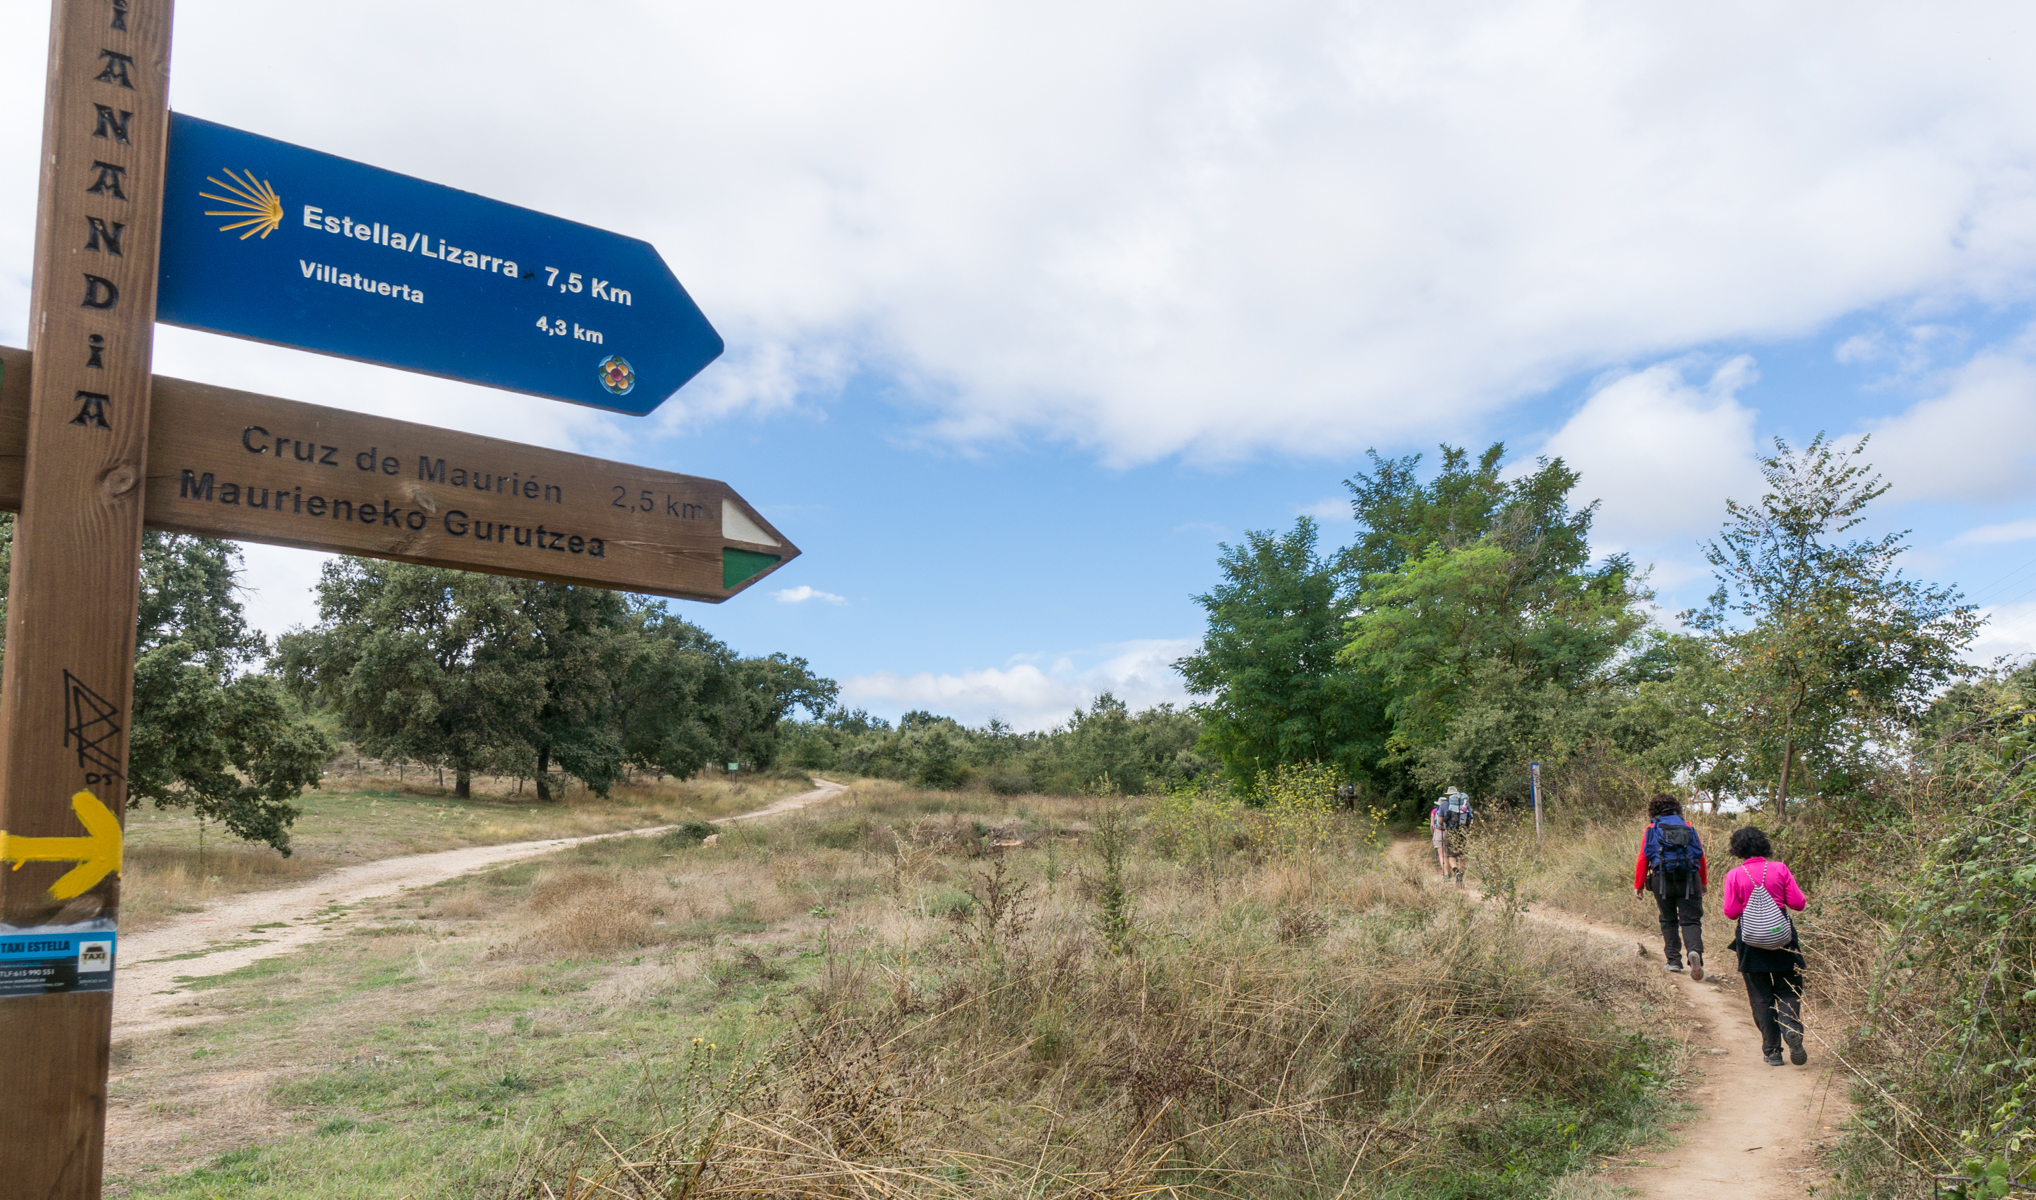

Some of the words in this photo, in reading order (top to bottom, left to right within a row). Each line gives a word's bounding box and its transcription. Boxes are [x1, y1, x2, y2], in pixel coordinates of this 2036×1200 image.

[303, 205, 518, 278] Estella/Lizarra
[545, 266, 583, 294] 7,5
[592, 277, 632, 306] Km
[300, 259, 424, 303] Villatuerta
[536, 315, 567, 336] 4,3
[573, 323, 603, 344] km
[242, 425, 339, 467] Cruz
[356, 447, 400, 476] de
[418, 455, 562, 504] Maurién
[611, 485, 655, 514] 2,5
[667, 495, 704, 521] km
[180, 468, 427, 541] Maurieneko
[444, 509, 605, 558] Gurutzea
[1, 942, 24, 953] TAXI
[28, 941, 69, 952] ESTELLA
[81, 952, 106, 960] TAXI
[42, 968, 55, 976] 551
